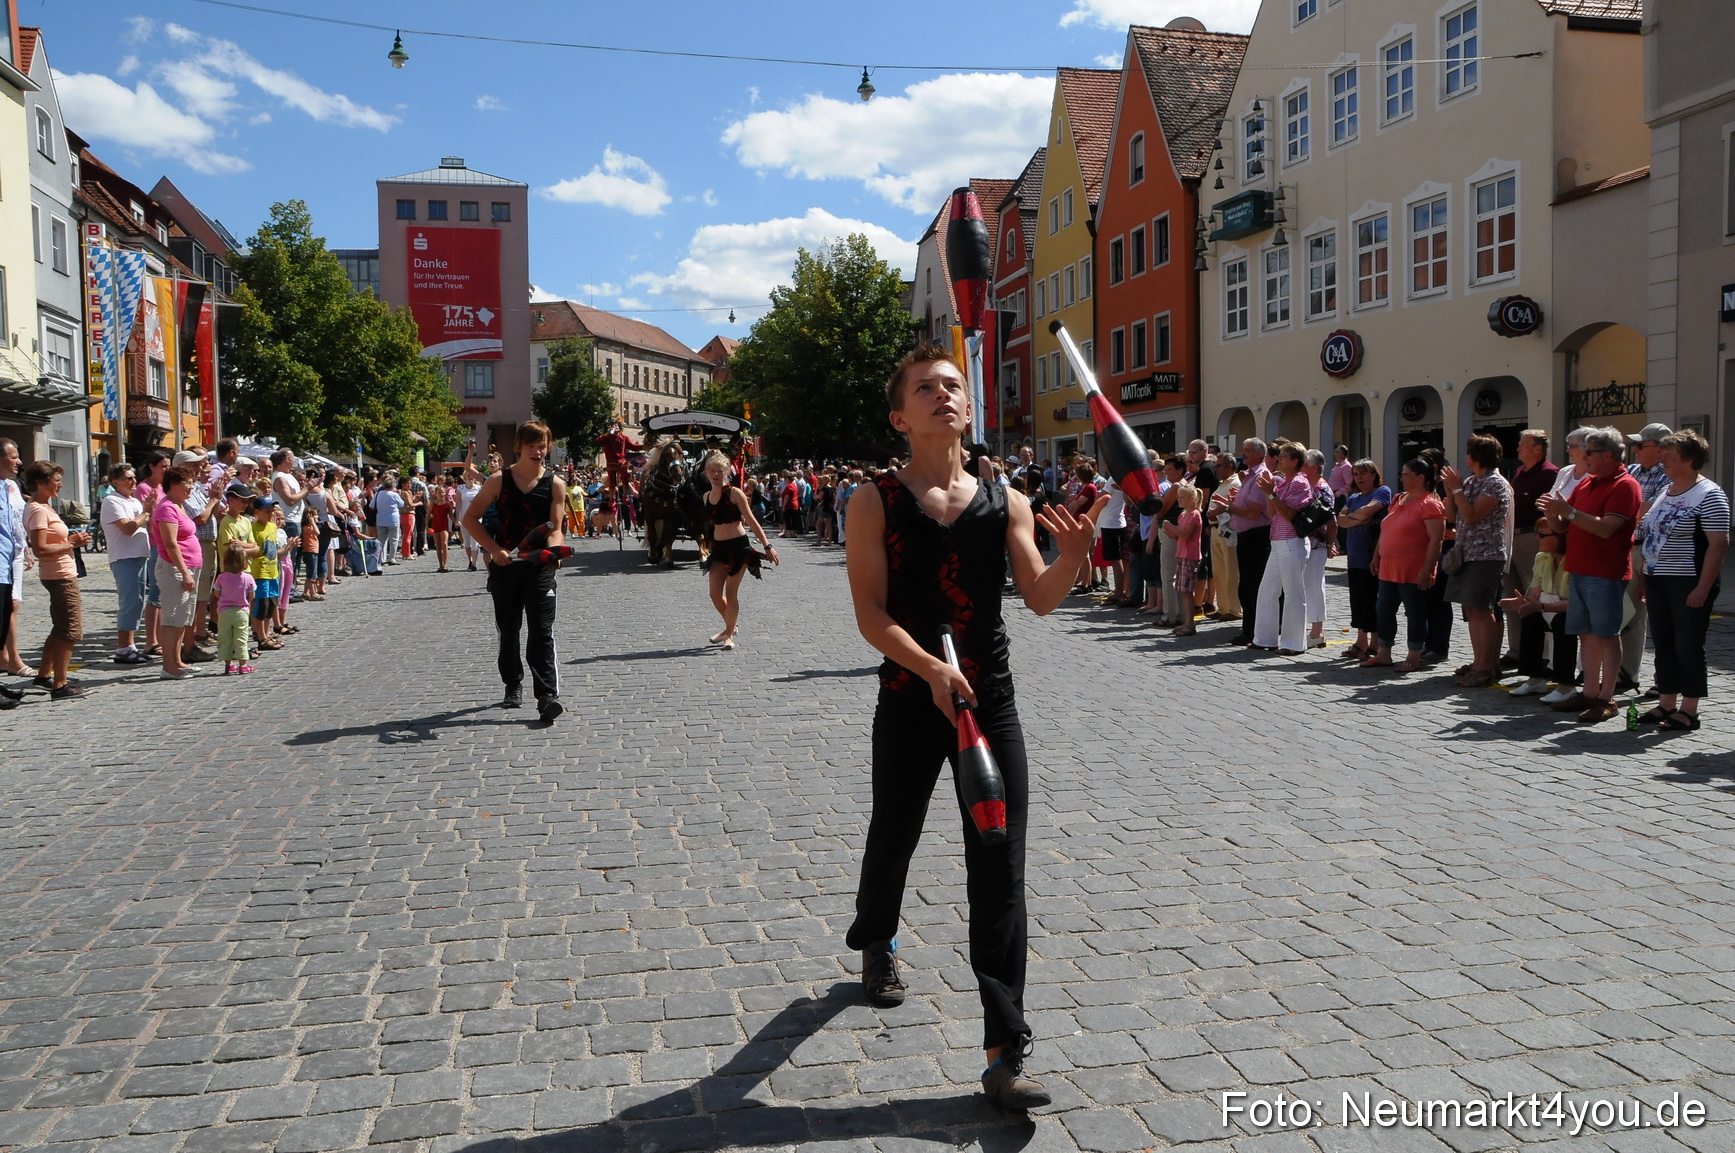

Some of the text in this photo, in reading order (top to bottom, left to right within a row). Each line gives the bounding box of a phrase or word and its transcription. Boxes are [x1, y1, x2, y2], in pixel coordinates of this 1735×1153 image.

[413, 258, 448, 269] Danke
[413, 272, 424, 280] für
[444, 282, 465, 290] Treue.
[442, 305, 474, 319] 175
[1507, 306, 1534, 324] C&A
[443, 319, 474, 327] JAHRE
[1325, 342, 1349, 364] C&A
[1154, 374, 1178, 383] MATT
[1536, 399, 1542, 407] 7
